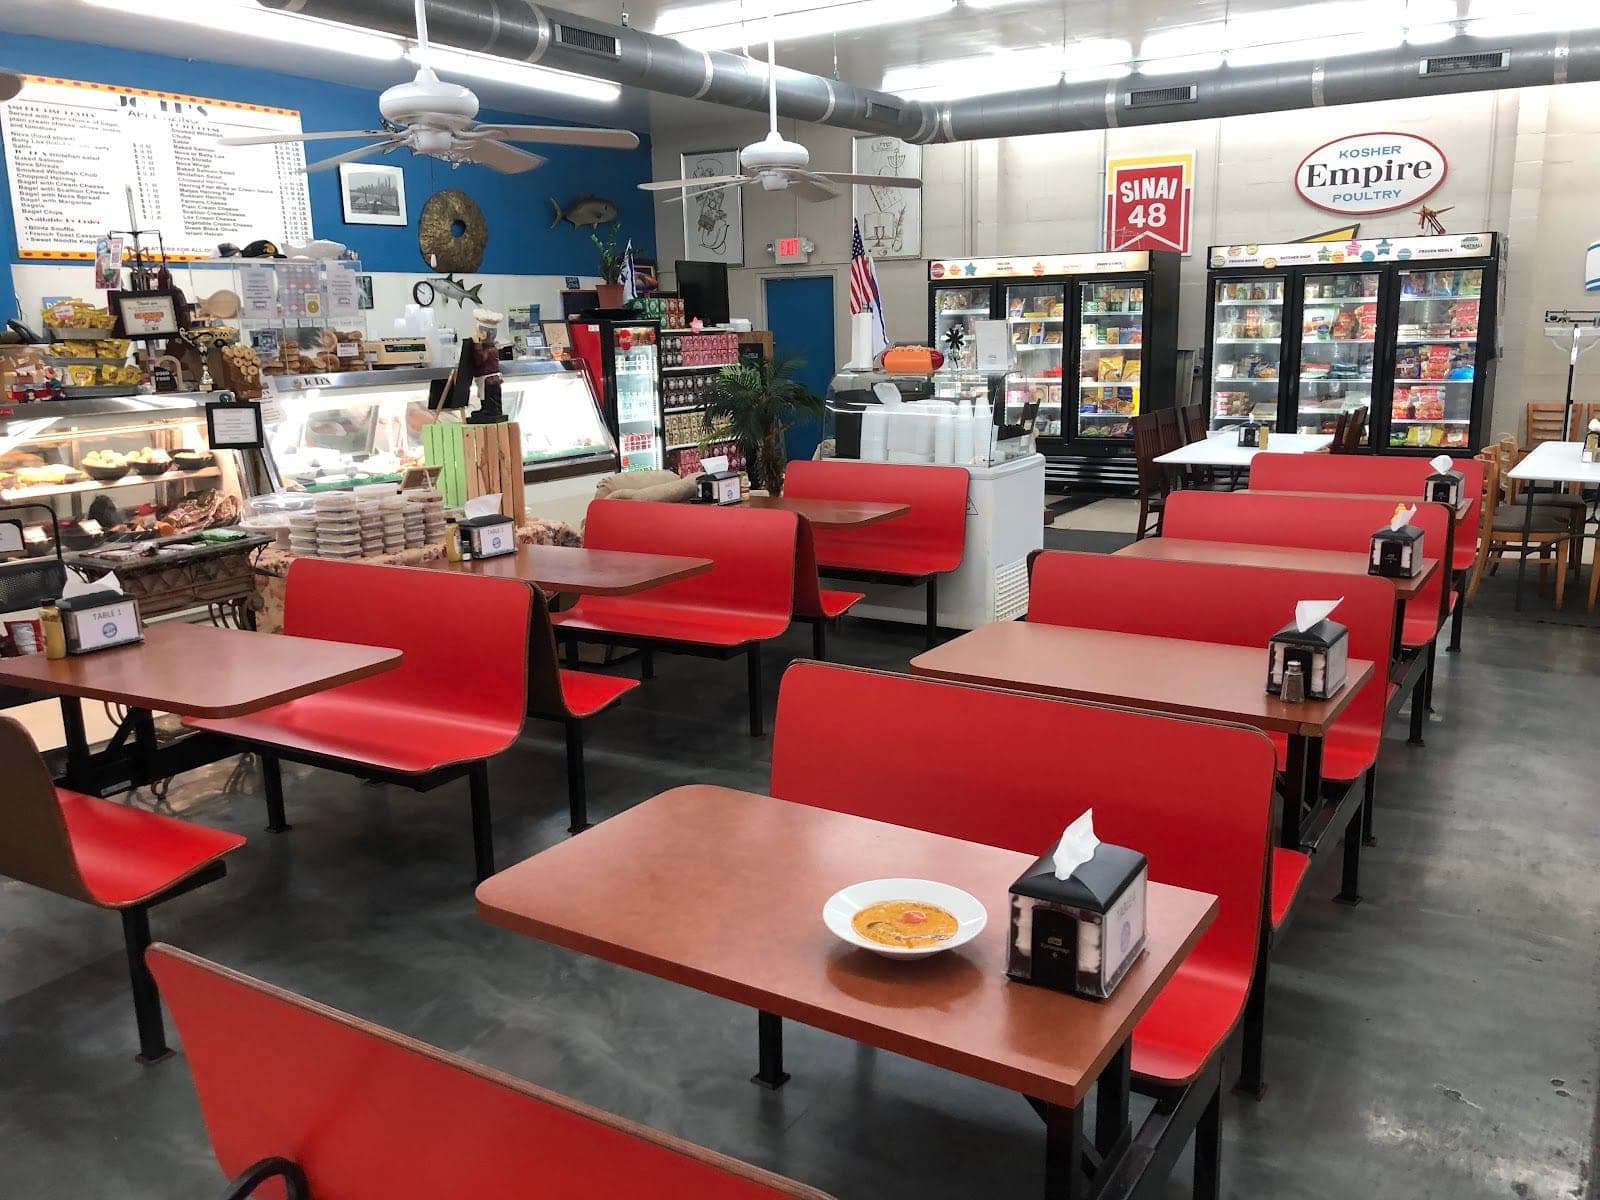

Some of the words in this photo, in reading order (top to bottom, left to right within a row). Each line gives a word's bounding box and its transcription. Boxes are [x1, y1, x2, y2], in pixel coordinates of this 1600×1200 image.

[1339, 146, 1402, 159] KOSHER
[1305, 160, 1432, 188] Empire
[1120, 177, 1178, 203] SINAI
[1332, 190, 1402, 203] POULTRY
[1128, 203, 1166, 228] 48
[780, 240, 798, 256] EXIT
[93, 610, 114, 620] TABLE
